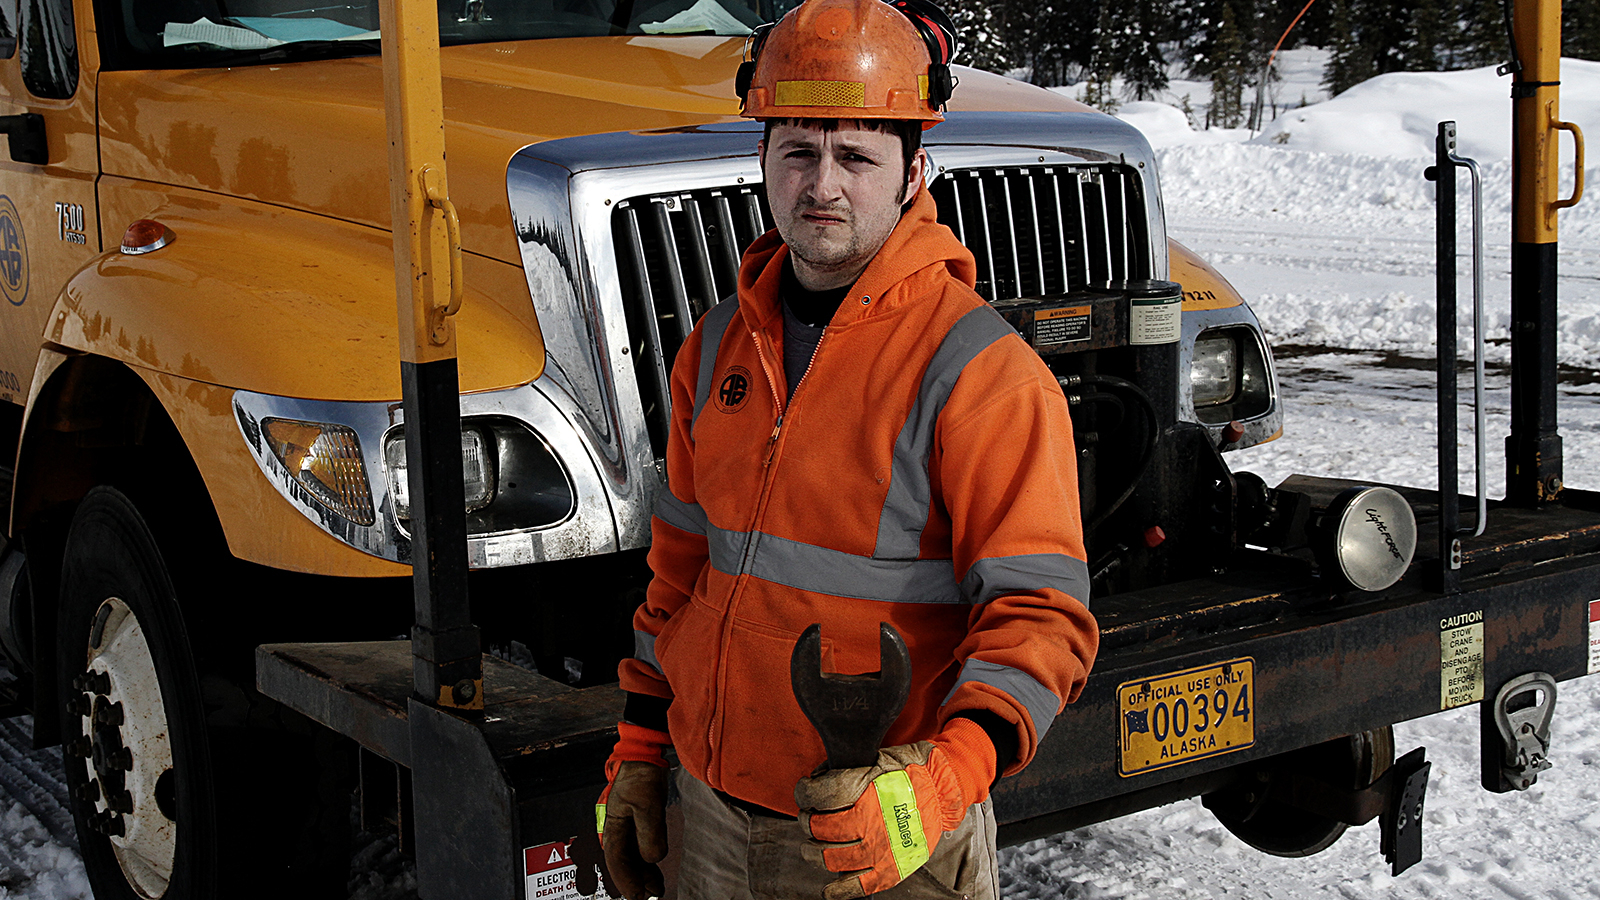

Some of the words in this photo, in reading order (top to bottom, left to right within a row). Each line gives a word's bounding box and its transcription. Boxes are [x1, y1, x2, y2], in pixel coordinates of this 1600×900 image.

[55, 202, 84, 240] 7500
[1440, 610, 1483, 629] CAUTION
[1451, 627, 1472, 638] STOW
[1450, 636, 1473, 648] CRANE
[1455, 647, 1469, 656] AND
[1442, 653, 1481, 669] DISENGAGE
[1455, 666, 1469, 675] PTO
[1448, 674, 1476, 686] BEFORE
[1128, 684, 1183, 706] OFFICIAL
[1188, 677, 1211, 692] USE
[1215, 670, 1244, 687] ONLY
[1448, 683, 1475, 696] MOVING
[1450, 693, 1473, 704] TRUCK
[1153, 684, 1250, 742] 00394
[1160, 734, 1216, 759] ALASKA
[537, 869, 577, 888] ELECTRO
[535, 884, 564, 898] DEATH
